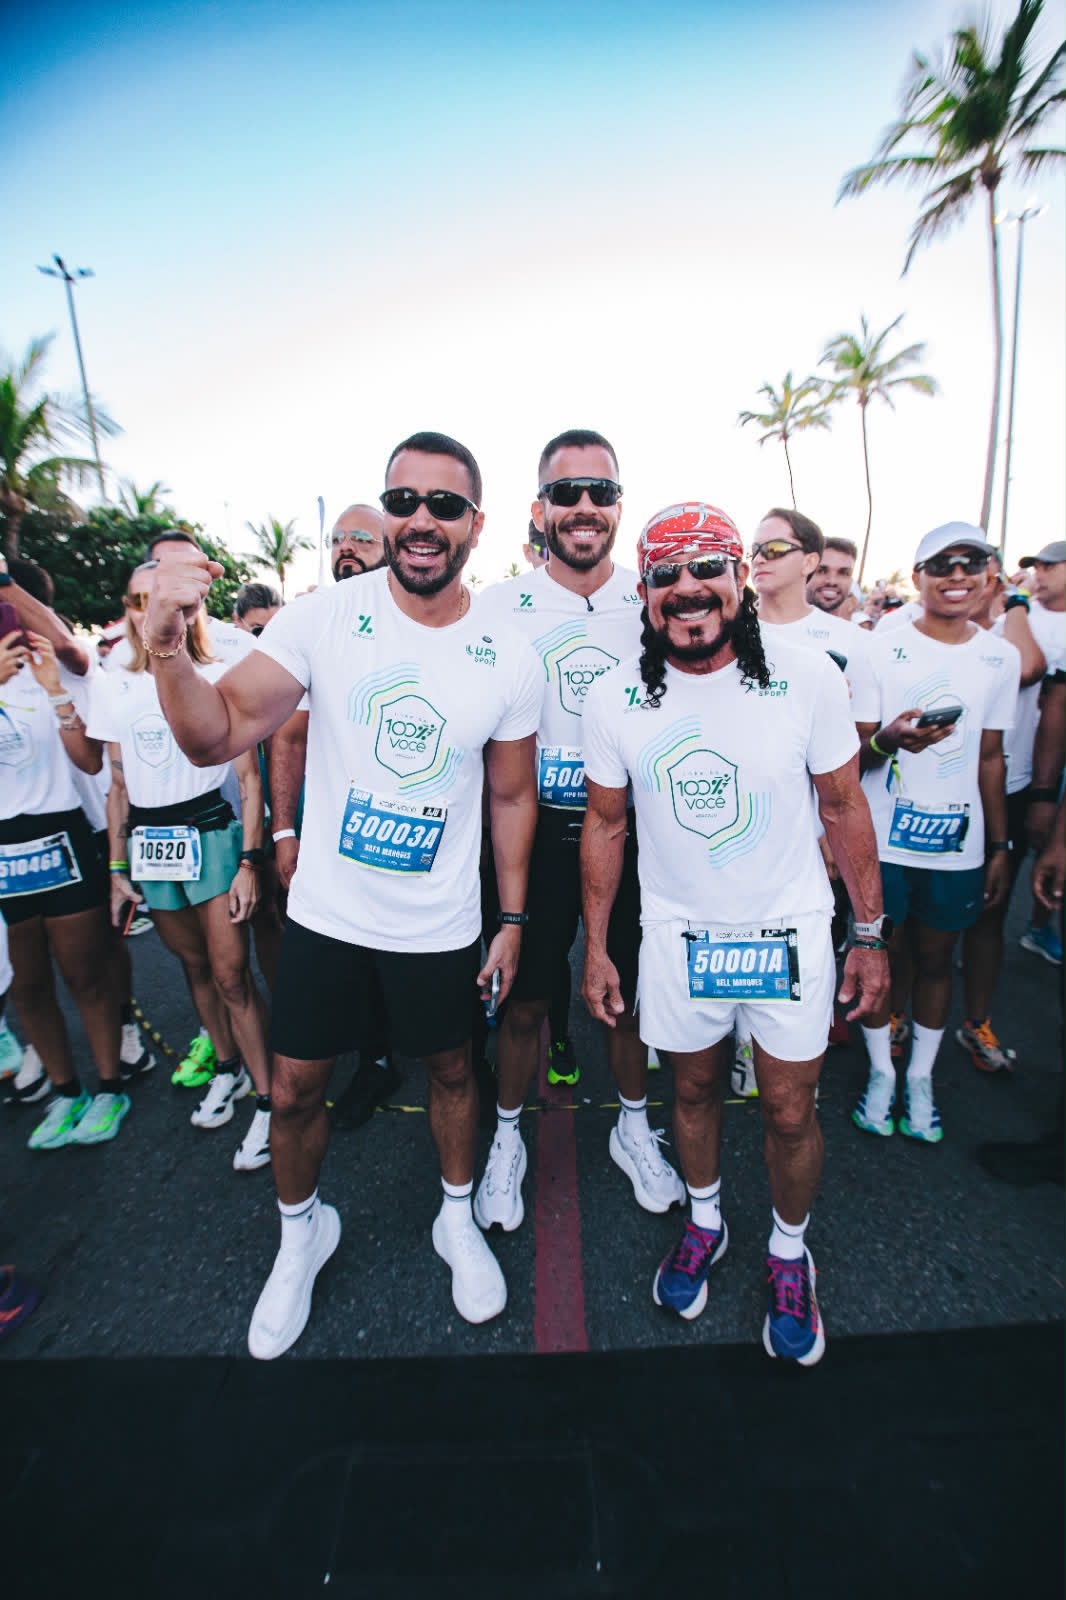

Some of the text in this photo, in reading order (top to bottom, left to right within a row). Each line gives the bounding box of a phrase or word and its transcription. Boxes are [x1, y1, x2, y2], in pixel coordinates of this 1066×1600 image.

[543, 766, 587, 788] 500
[345, 810, 441, 850] 50003A
[140, 841, 186, 860] 10620
[693, 948, 783, 974] 50001A
